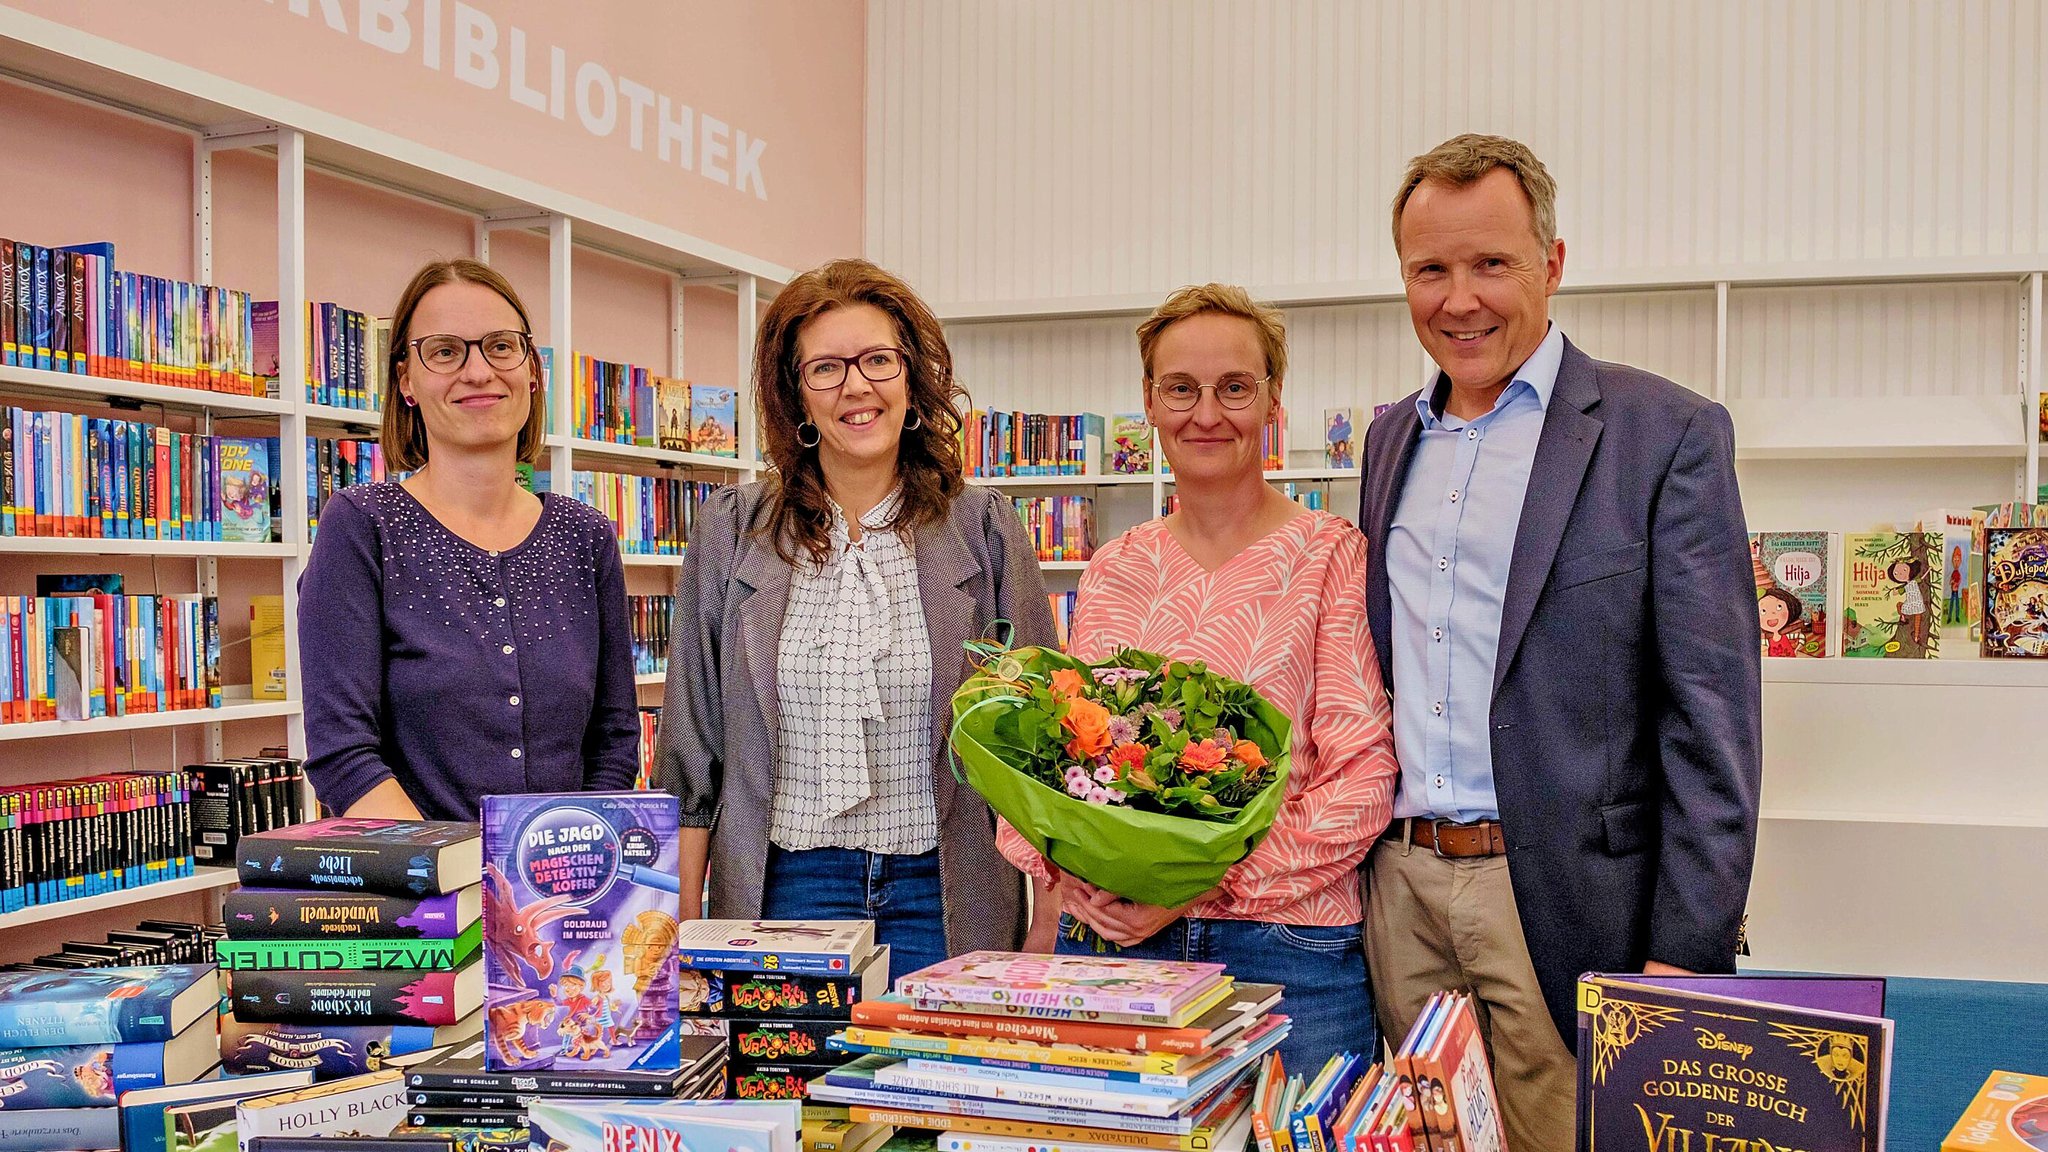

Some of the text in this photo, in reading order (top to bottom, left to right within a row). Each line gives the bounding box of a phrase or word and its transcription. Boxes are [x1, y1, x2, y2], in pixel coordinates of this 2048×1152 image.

[264, 0, 768, 201] BIBLIOTHEK
[2, 262, 13, 308] ANIMOX
[18, 266, 30, 311] ANIMOX
[36, 269, 48, 313] ANIMOX
[55, 272, 65, 316] ANIMOX
[73, 276, 83, 321] ANIMOX
[220, 445, 249, 458] ODY
[220, 458, 254, 471] ONE
[1785, 565, 1810, 586] Hilja
[1853, 562, 1886, 588] Hilja
[528, 824, 604, 847] DIE JAGD
[548, 844, 591, 856] NACH DEM
[624, 848, 651, 857] RÄTSELN
[319, 855, 352, 875] Liebe
[529, 854, 604, 872] MAGISCHEN
[535, 866, 603, 884] DETEKTIV-
[552, 879, 597, 894] KOFFER
[300, 905, 379, 923] Wunderwelt
[320, 924, 361, 933] Leuchtende
[563, 921, 607, 929] GOLDRAUB
[576, 931, 612, 939] MUSEUM
[361, 949, 454, 970] MAZE
[763, 954, 779, 970] 26
[310, 988, 371, 998] und ihr Geheimnis
[1015, 992, 1060, 1006] HEIDI
[1585, 989, 1601, 1007] D
[310, 999, 372, 1015] Die Schöne
[17, 1016, 64, 1026] TITANEN
[897, 1013, 1058, 1041] Märchen von Hans Christian Andersen
[3, 1027, 65, 1037] DER FLUCH
[302, 1039, 332, 1050] GOOD
[637, 1029, 675, 1067] Ravensburger
[1161, 1038, 1194, 1048] esslinger
[1693, 1027, 1755, 1061] Disney
[272, 1054, 319, 1067] SCHOOL
[1011, 1060, 1030, 1070] SABINE
[1067, 1055, 1132, 1067] WOHLLEBEN REICH
[3, 1062, 39, 1078] GOOD
[1086, 1069, 1109, 1078] MADLEN
[1663, 1060, 1788, 1094] DAS GROSSE
[891, 1075, 914, 1087] KATZE
[916, 1077, 933, 1089] EINE
[934, 1080, 959, 1092] SEHEN
[961, 1083, 979, 1094] ALLE
[1017, 1091, 1052, 1101] WENZEL
[1151, 1087, 1173, 1095] Moritz
[1644, 1081, 1809, 1124] GOLDENE BUCH
[279, 1092, 407, 1131] HOLLY BLACK
[869, 1112, 952, 1128] EDDIE MEISTERDIEB
[1706, 1111, 1736, 1128] DER
[11, 1127, 61, 1137] verzauberte
[62, 1127, 80, 1136] Das
[1088, 1132, 1148, 1144] DULLY&DAX
